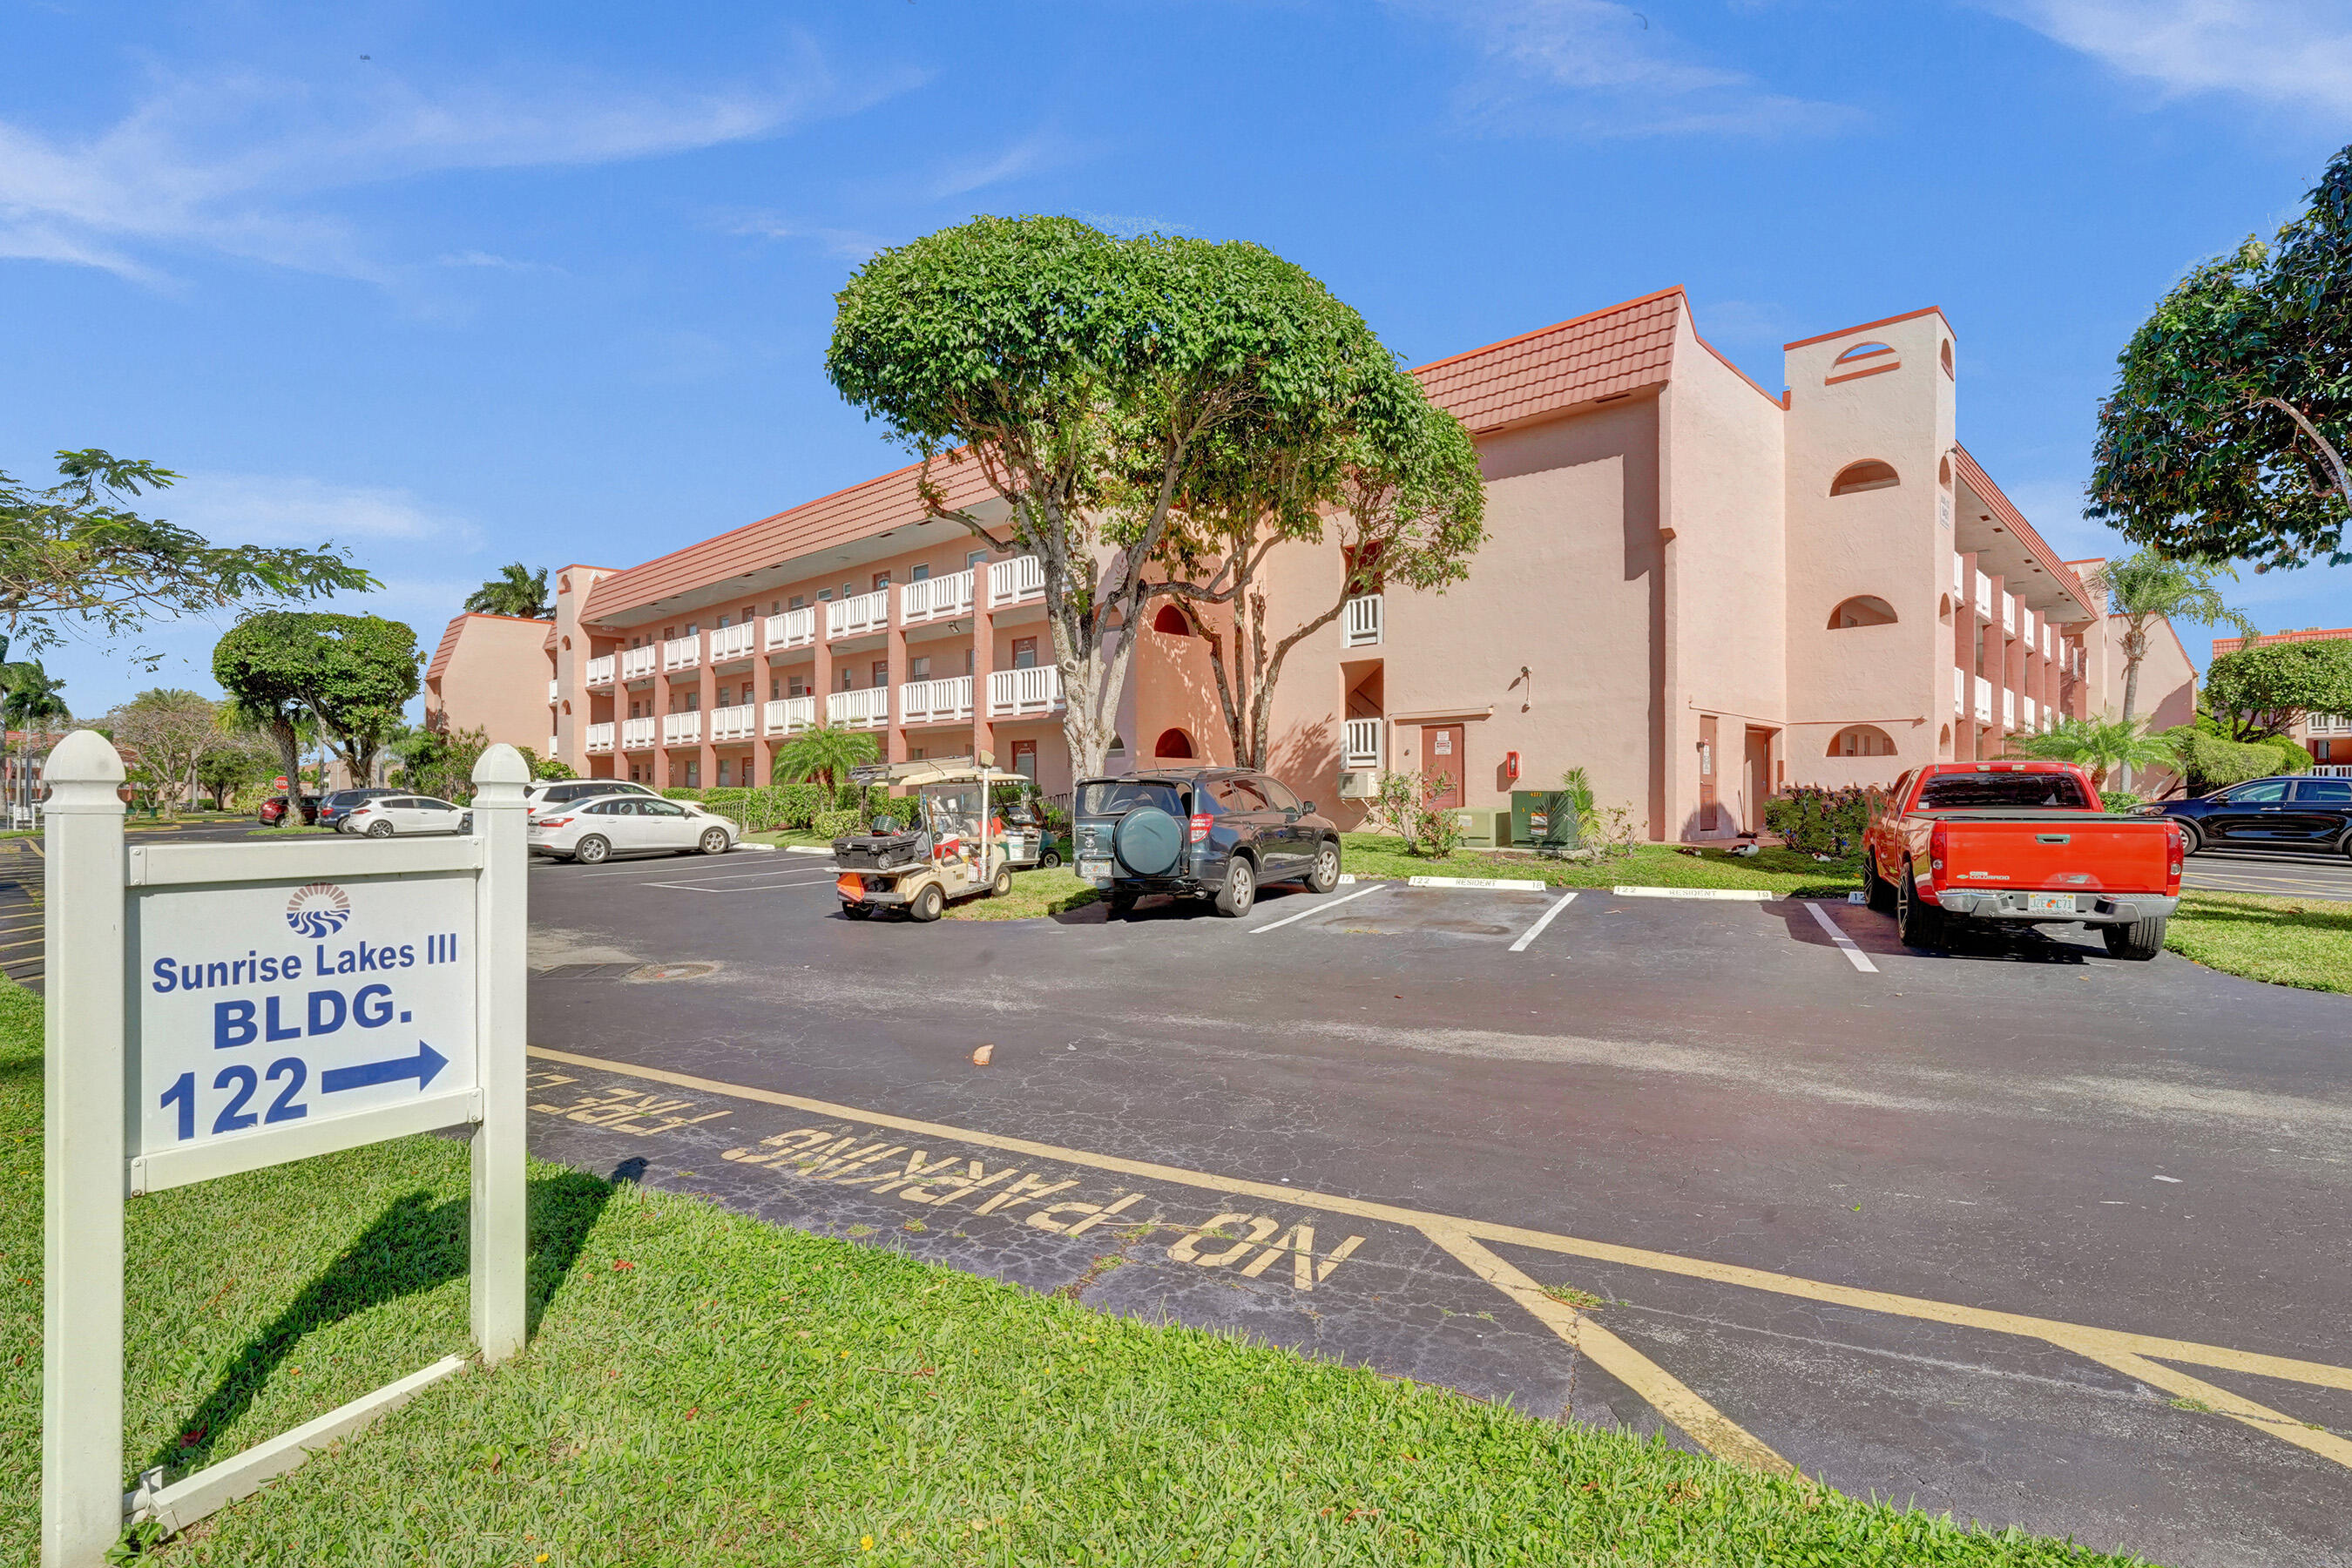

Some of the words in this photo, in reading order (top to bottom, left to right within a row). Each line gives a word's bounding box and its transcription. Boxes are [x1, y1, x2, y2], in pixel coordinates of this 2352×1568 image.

[1456, 878, 1497, 887] RESIDENT
[152, 950, 302, 993] Sunrise
[316, 941, 416, 977] Lakes
[428, 933, 456, 964] III
[213, 983, 412, 1050] BLDG.
[160, 1057, 308, 1141] 122
[526, 1088, 734, 1137] FIRE
[721, 1127, 1147, 1236] PARKING
[1166, 1212, 1367, 1292] NO
